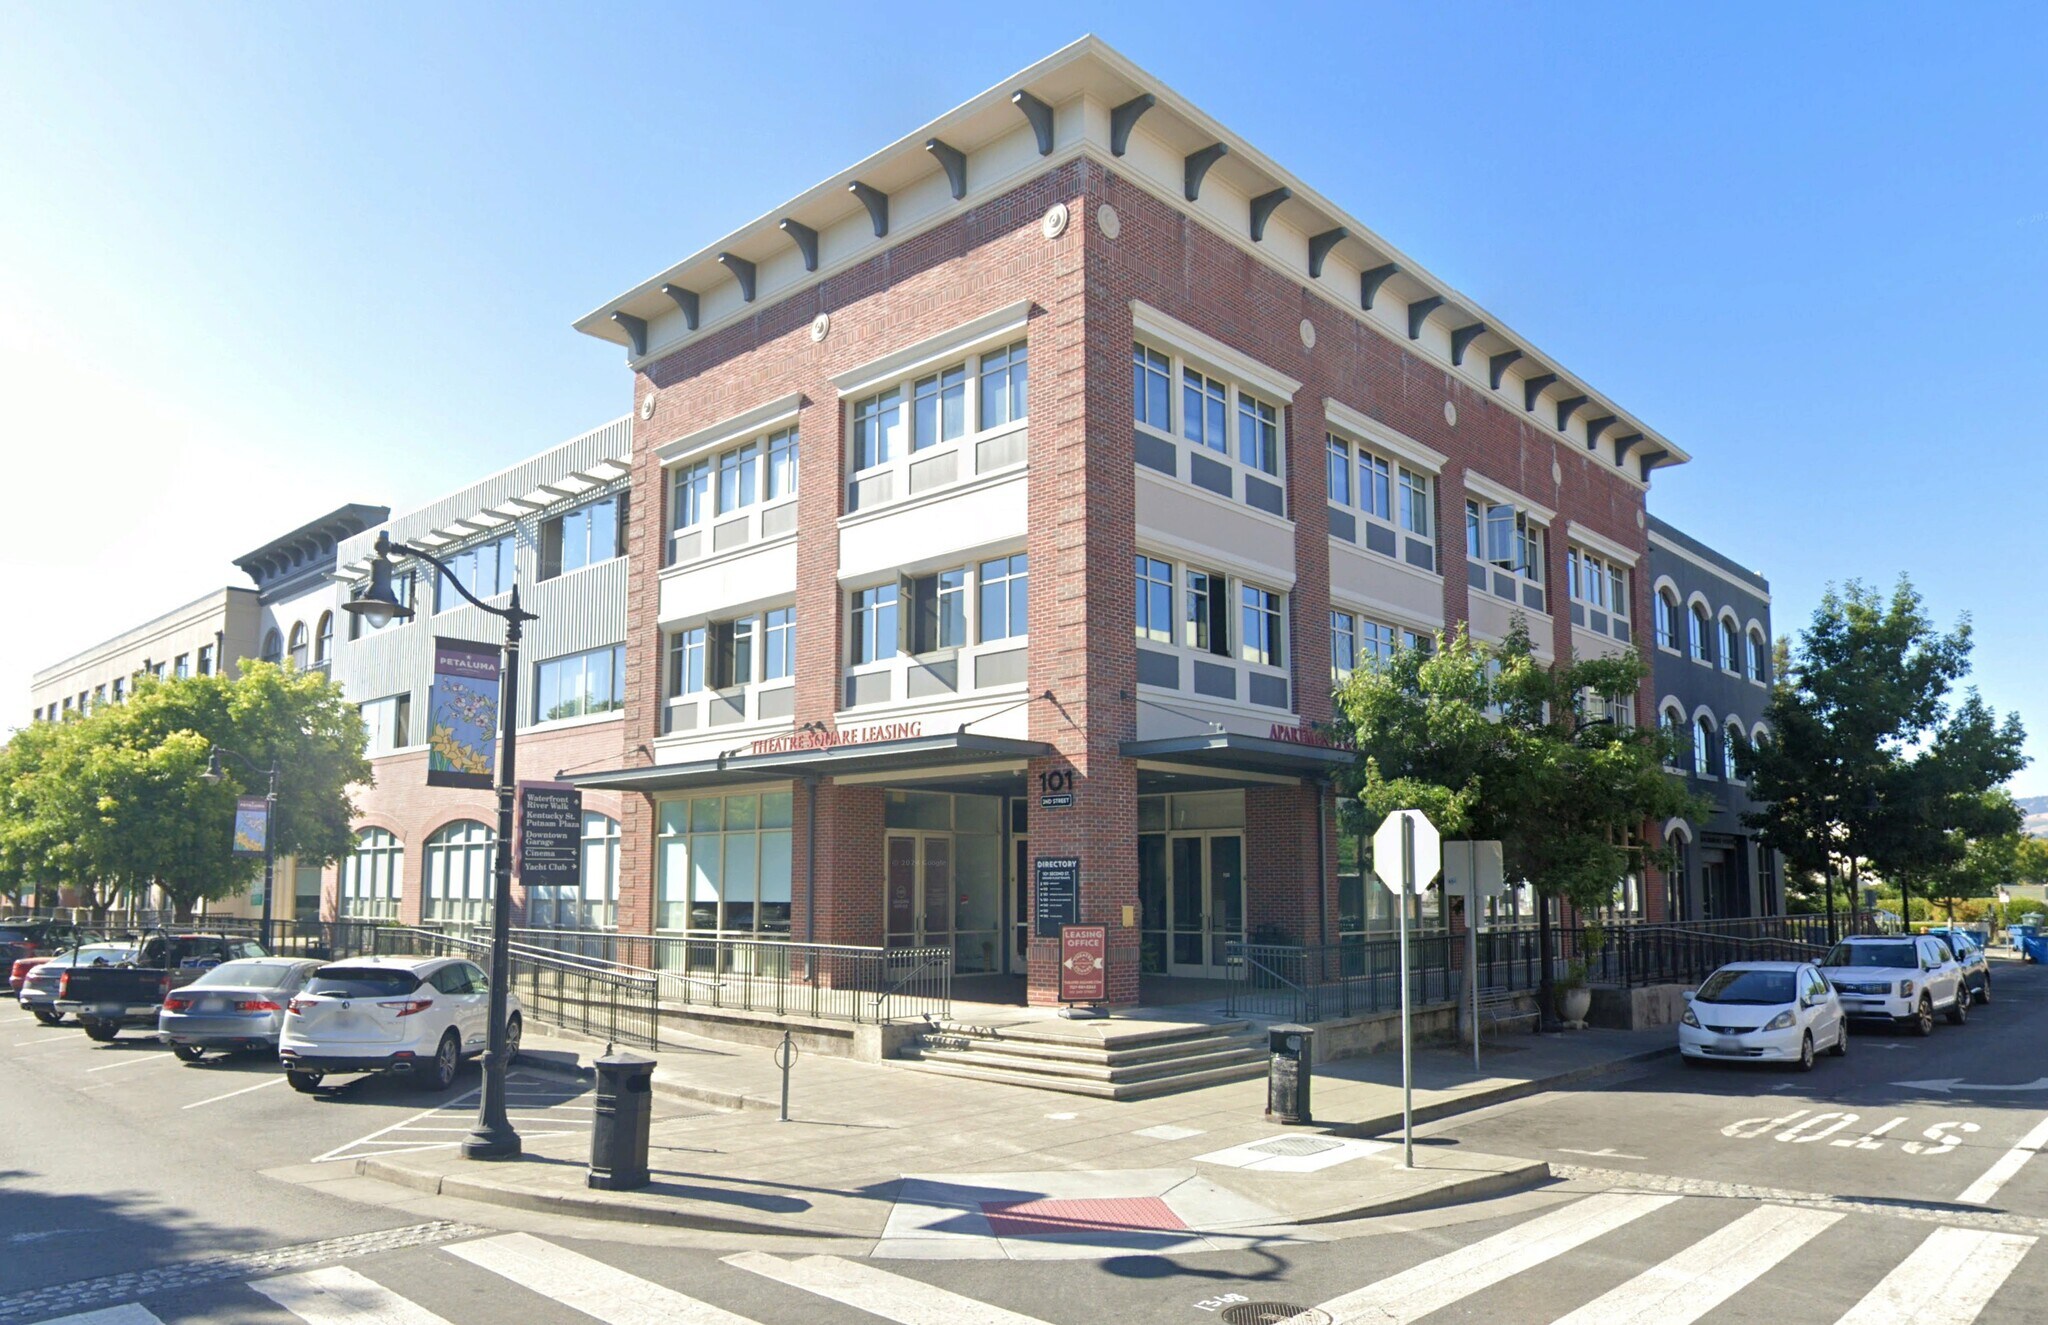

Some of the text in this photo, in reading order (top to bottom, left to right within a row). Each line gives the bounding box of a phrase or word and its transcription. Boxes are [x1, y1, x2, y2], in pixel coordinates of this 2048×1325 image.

[440, 657, 496, 672] PETALUMA
[751, 721, 922, 754] THEATRE SQUARE LEASING
[1039, 770, 1073, 792] 101
[527, 794, 569, 804] Waterfront
[1053, 797, 1070, 805] STREET
[527, 801, 549, 809] River
[526, 811, 576, 821] Kentucky St.
[526, 819, 580, 828] Putnam Plaza
[526, 831, 568, 839] Downtown
[525, 838, 554, 847] Garage
[525, 849, 555, 857] Cinema
[525, 863, 567, 871] Yacht Club
[1037, 860, 1077, 868] DIRECTORY
[1720, 1110, 1981, 1154] STOP
